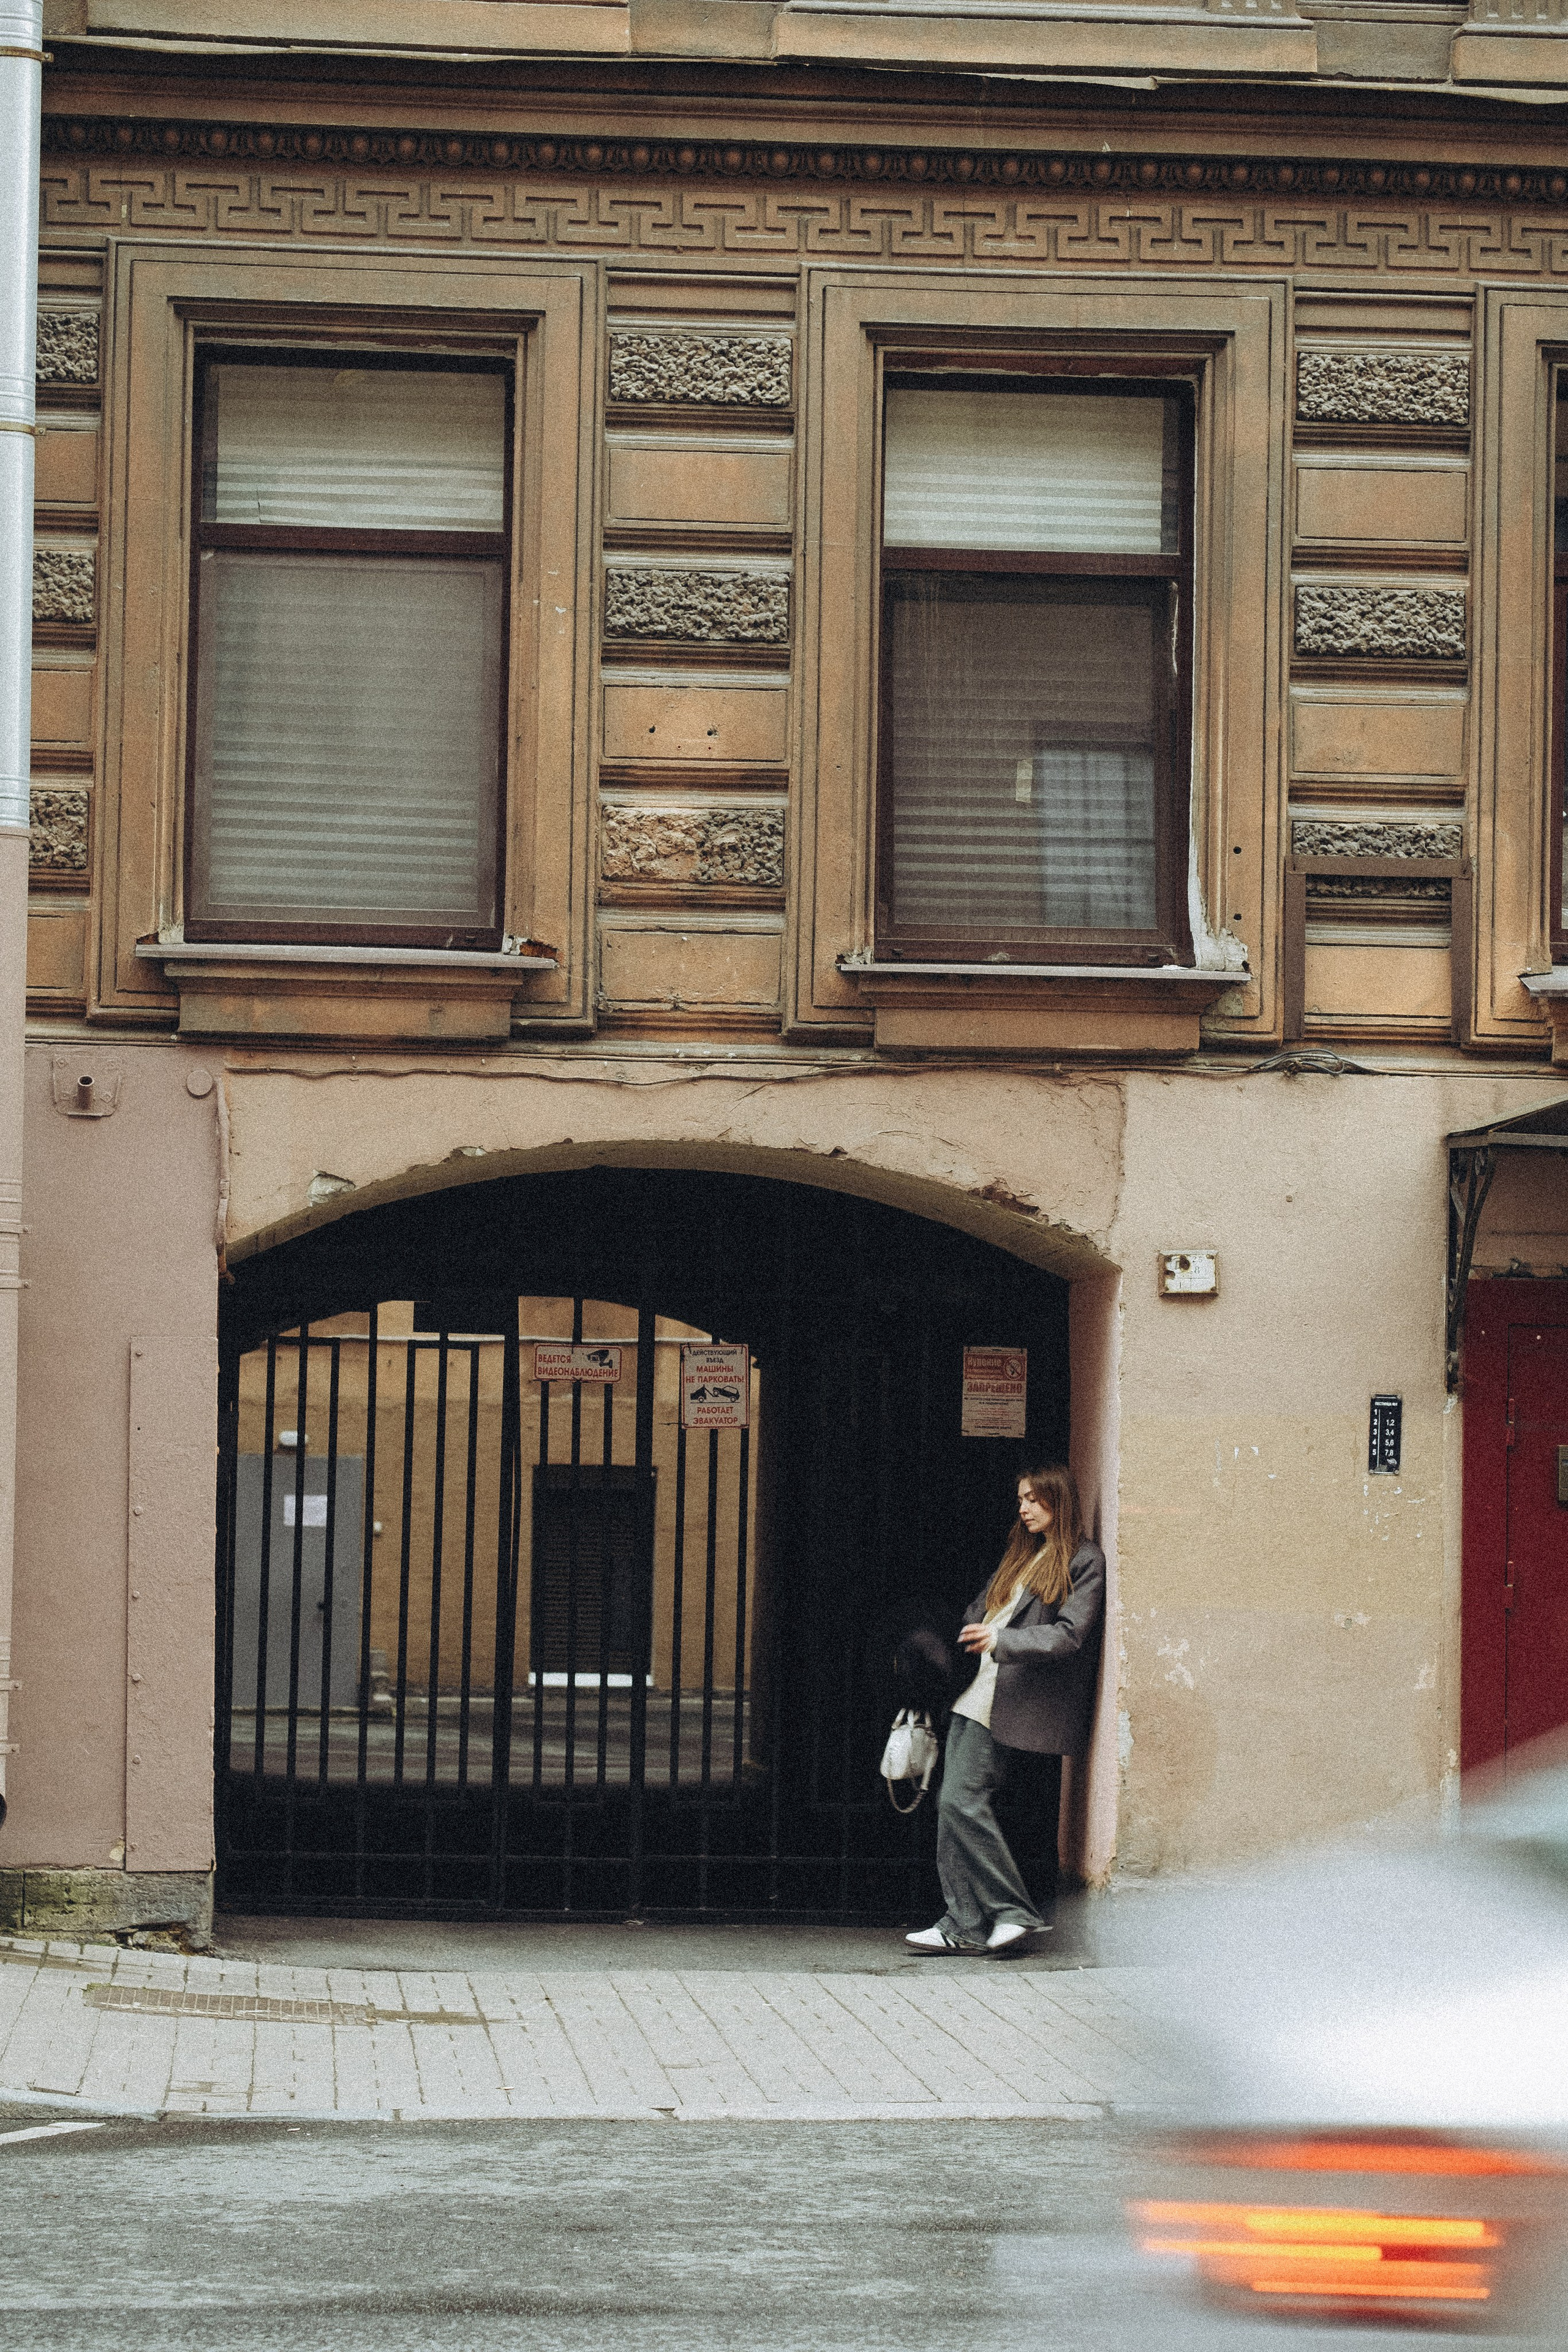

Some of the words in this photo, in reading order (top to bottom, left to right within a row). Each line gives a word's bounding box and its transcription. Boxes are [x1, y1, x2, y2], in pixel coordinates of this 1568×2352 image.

[538, 1354, 571, 1364] ВЕДЕТСЯ
[537, 1366, 618, 1378] ВИДЕОНАБЛЮДЕНИЕ
[967, 1382, 1022, 1393] ЗАПРЕЩЕНО
